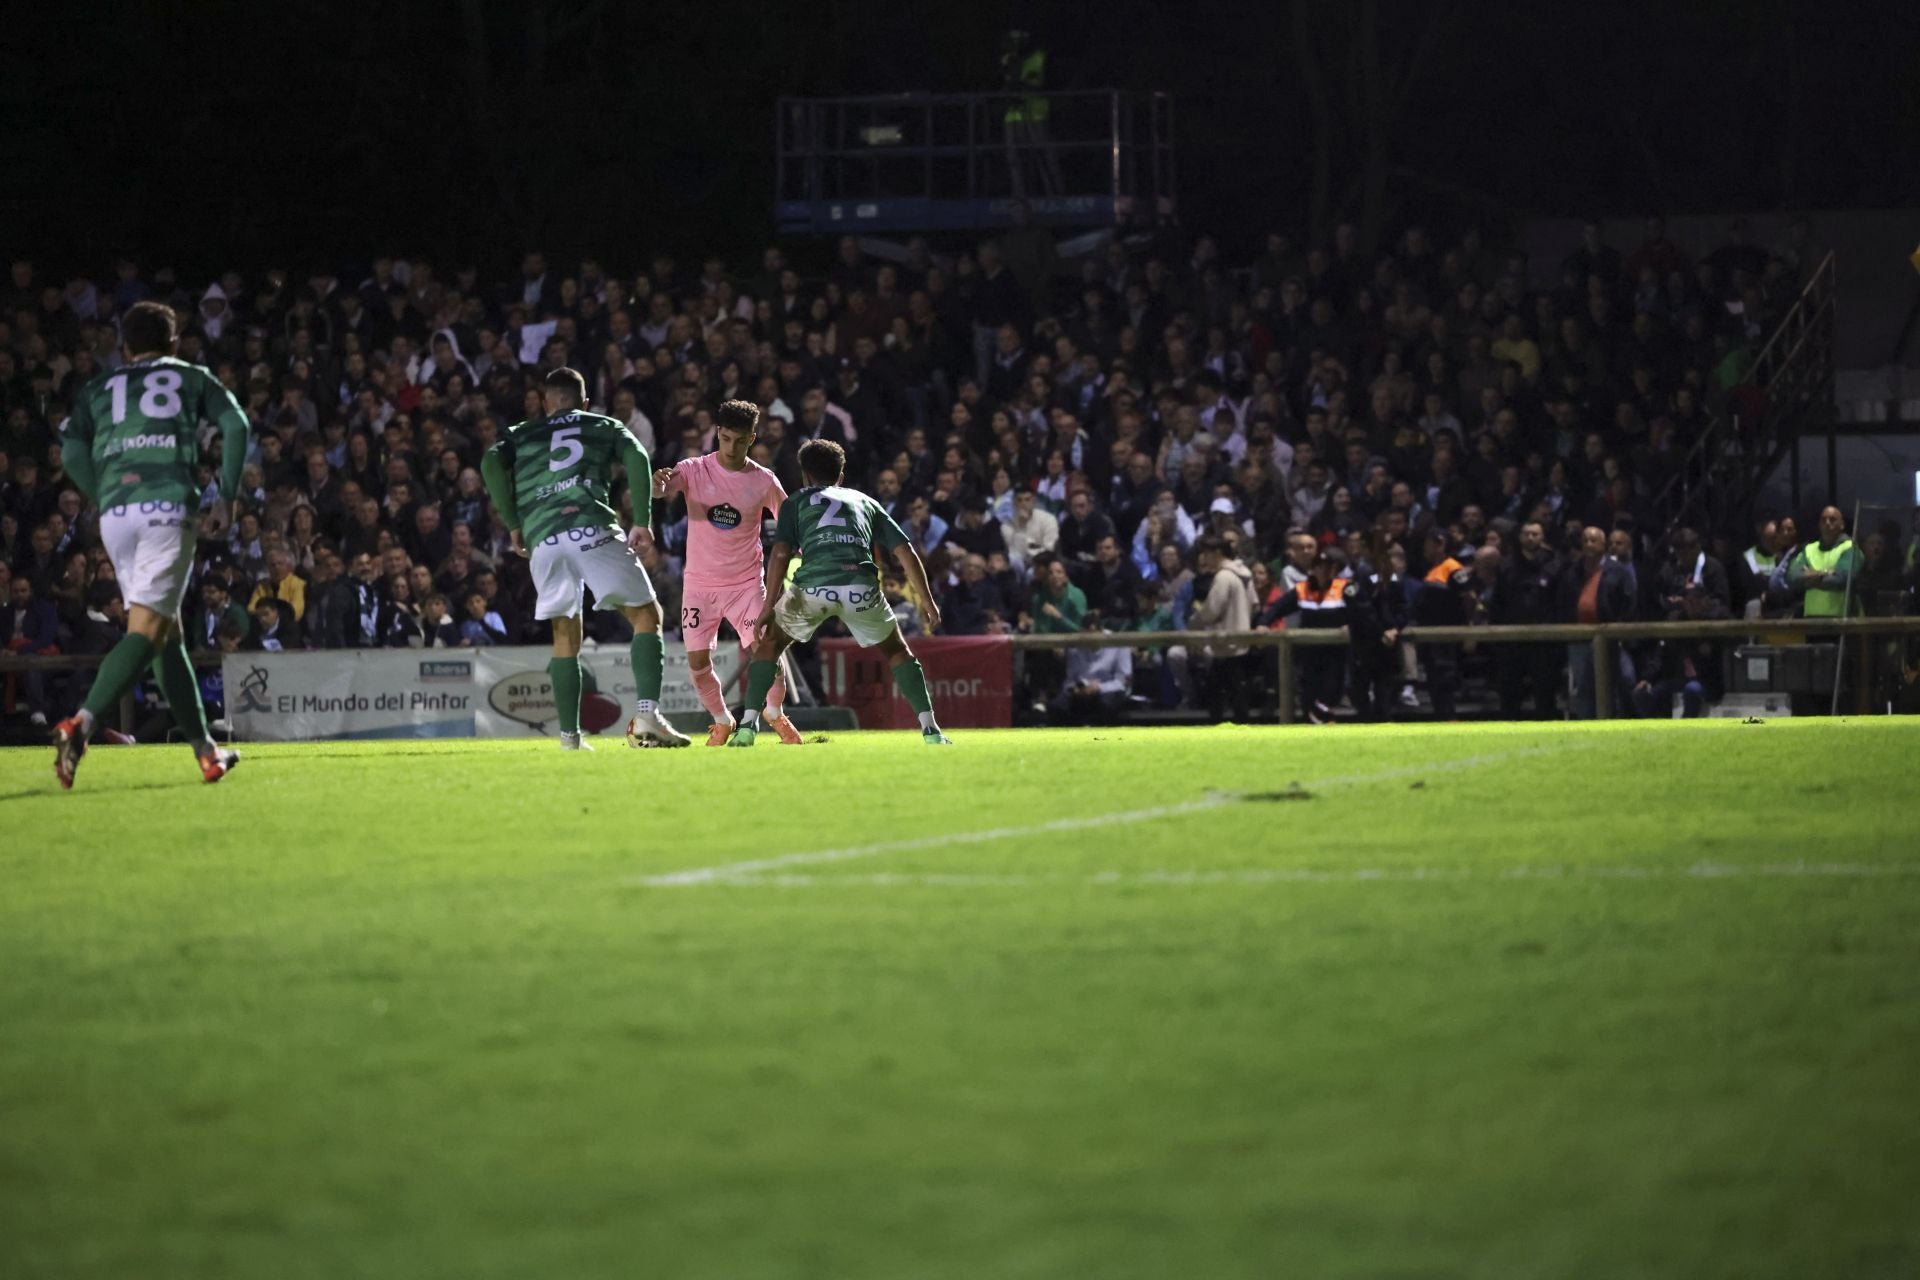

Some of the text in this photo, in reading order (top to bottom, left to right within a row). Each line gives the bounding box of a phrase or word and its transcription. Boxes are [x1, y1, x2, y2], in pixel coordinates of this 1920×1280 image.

[104, 369, 183, 425] 18
[548, 426, 584, 473] 5
[713, 508, 737, 520] Estrella
[809, 491, 847, 530] 2
[682, 607, 700, 629] 23
[278, 692, 470, 713] El Mundo del Pintor
